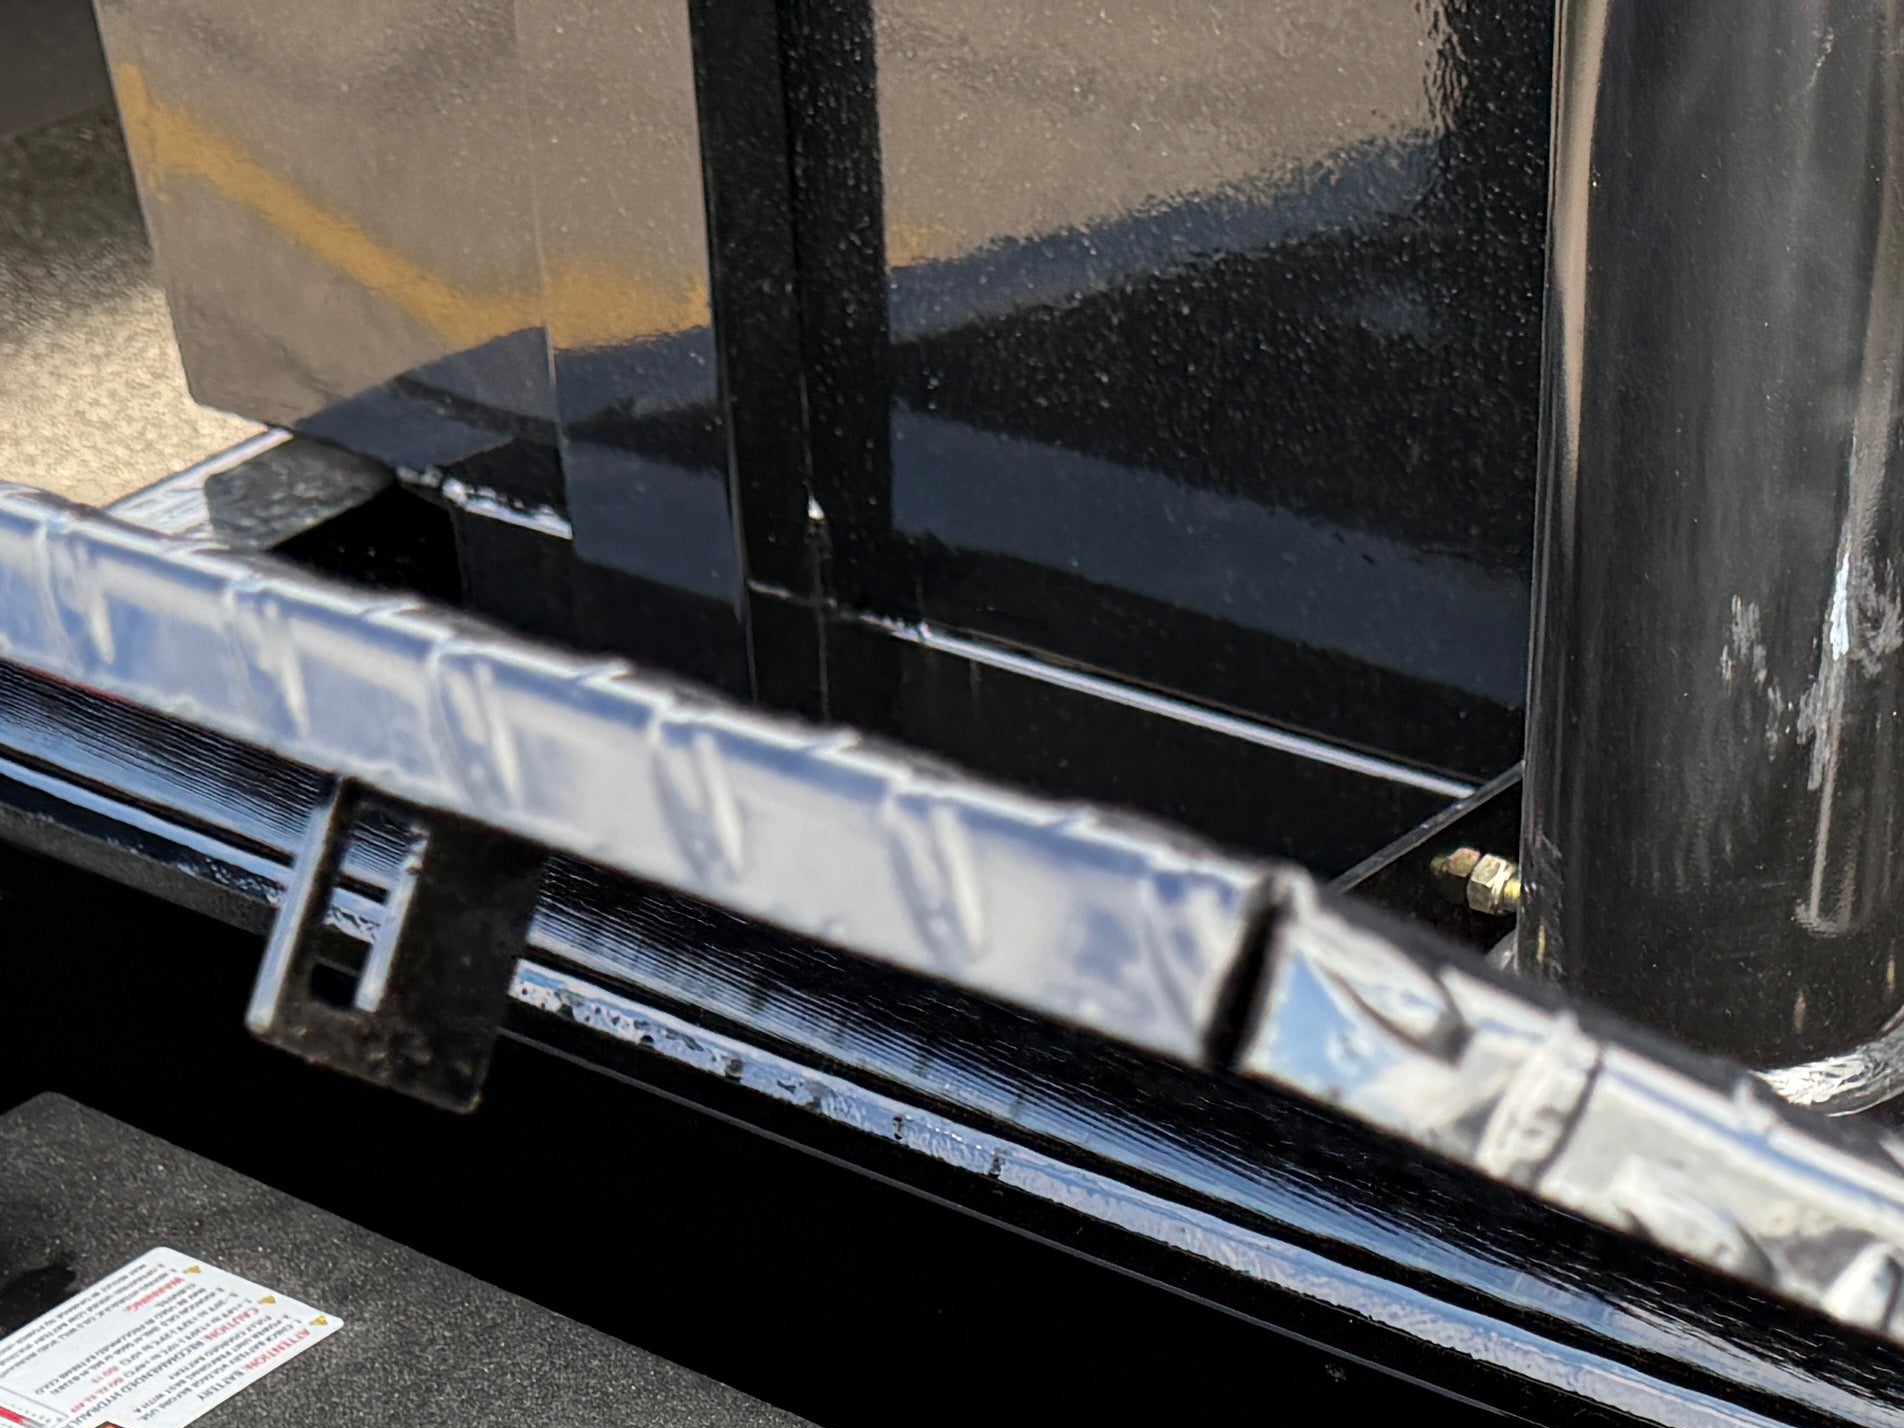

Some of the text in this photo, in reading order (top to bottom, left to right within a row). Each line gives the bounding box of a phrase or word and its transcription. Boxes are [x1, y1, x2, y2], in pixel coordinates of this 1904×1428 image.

[118, 1340, 206, 1394] RECOMMENDED
[194, 1327, 314, 1401] ATTENTION: BATTERY
